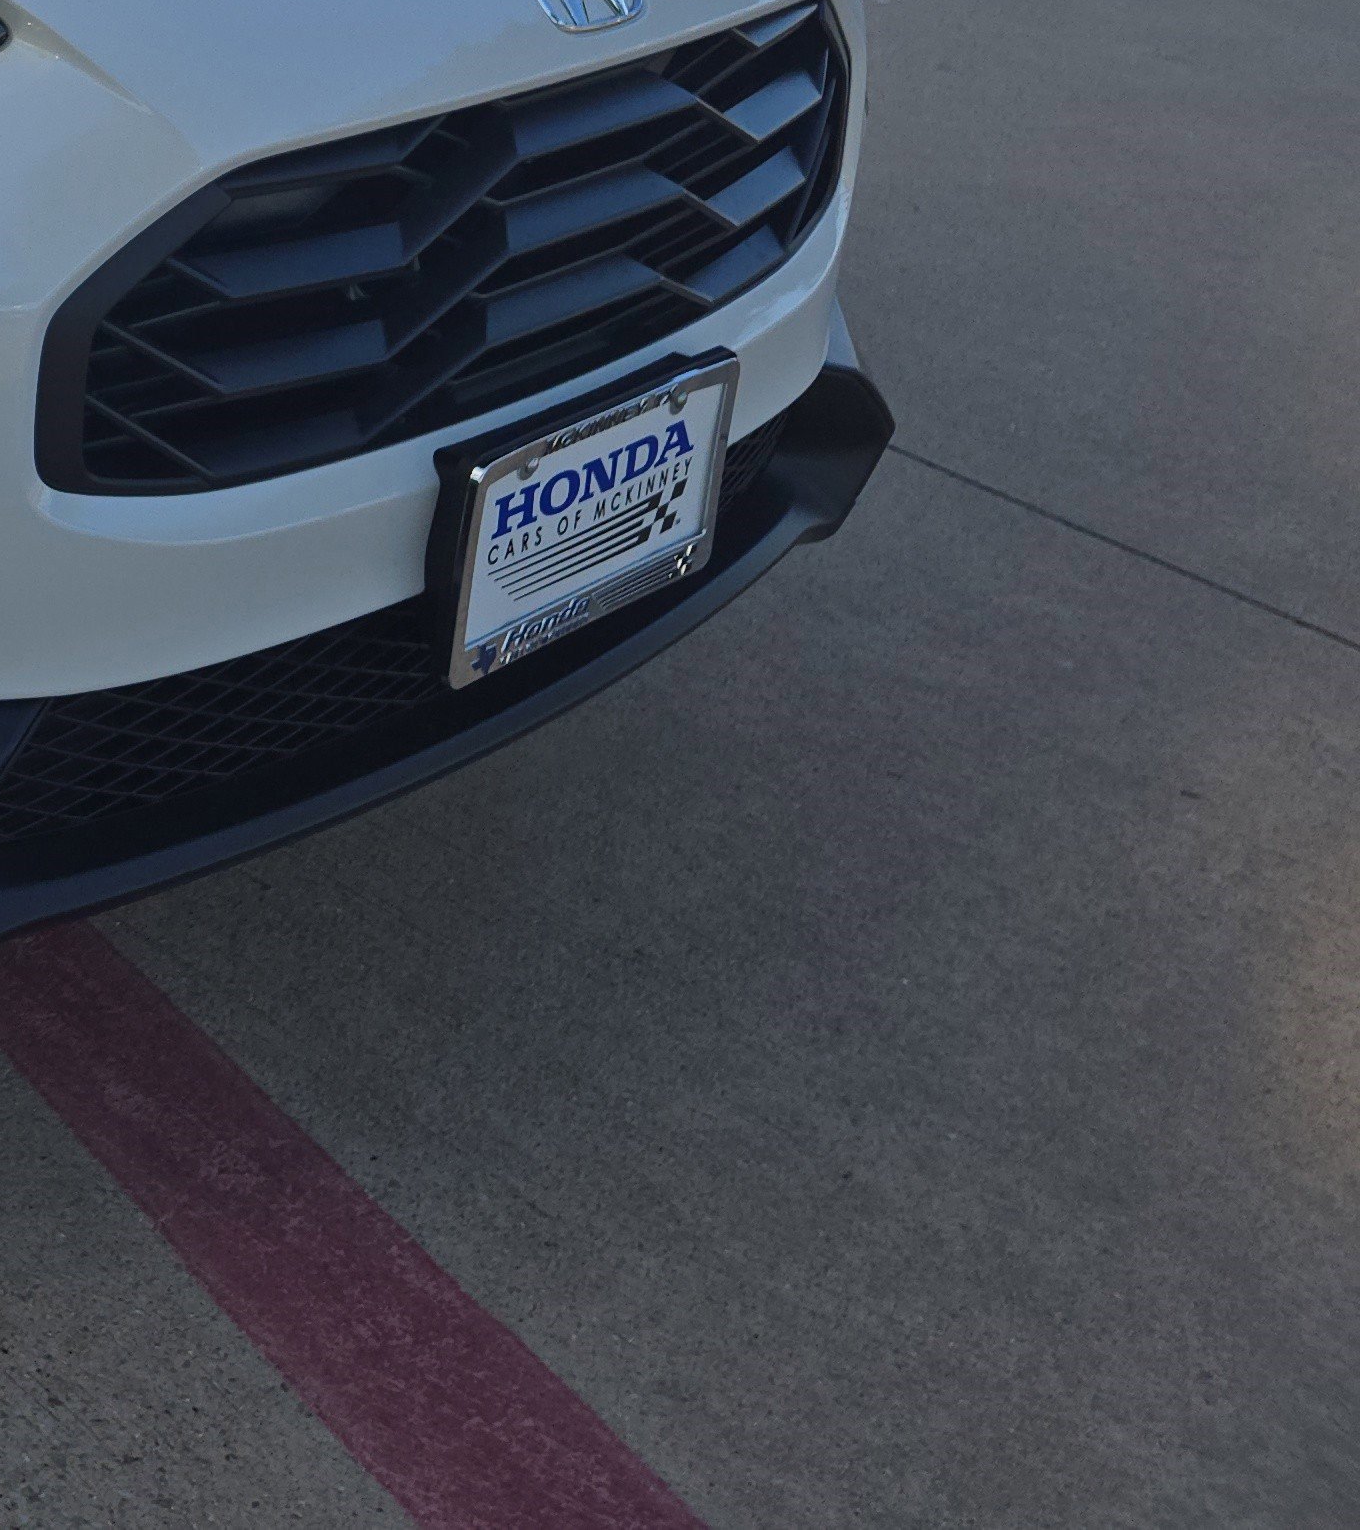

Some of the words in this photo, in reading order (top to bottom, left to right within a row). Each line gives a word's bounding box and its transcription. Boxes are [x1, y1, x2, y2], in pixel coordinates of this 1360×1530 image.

[487, 526, 543, 565] CARS
[556, 511, 582, 535] OF
[593, 456, 693, 520] MCKINNEY
[490, 420, 695, 540] HONDA
